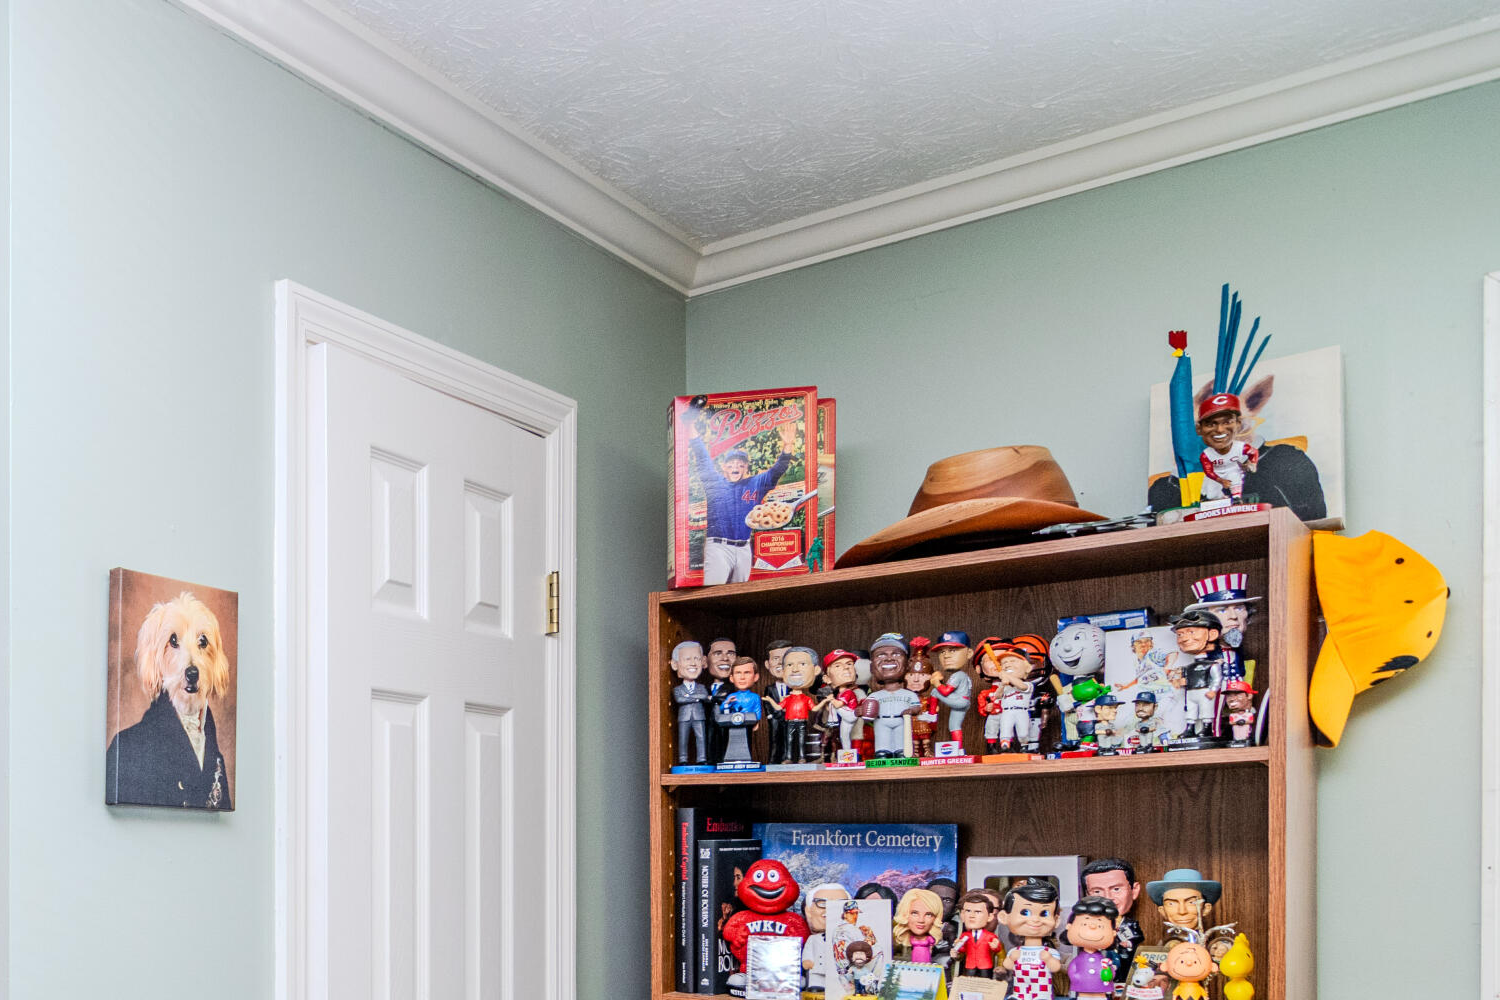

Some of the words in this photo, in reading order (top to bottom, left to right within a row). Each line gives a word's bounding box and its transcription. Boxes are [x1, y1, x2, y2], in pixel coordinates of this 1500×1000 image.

[710, 404, 803, 444] Rizzos
[741, 489, 759, 503] 44
[1194, 509, 1221, 520] BROOKS
[1221, 504, 1258, 515] LAWRENCE
[891, 757, 920, 766] SANDERS
[920, 758, 945, 766] HUNTER
[946, 756, 973, 764] GREENE
[791, 829, 862, 847] Frankfort
[865, 830, 944, 853] Cemetery
[702, 889, 708, 898] OF
[746, 919, 788, 935] WKU
